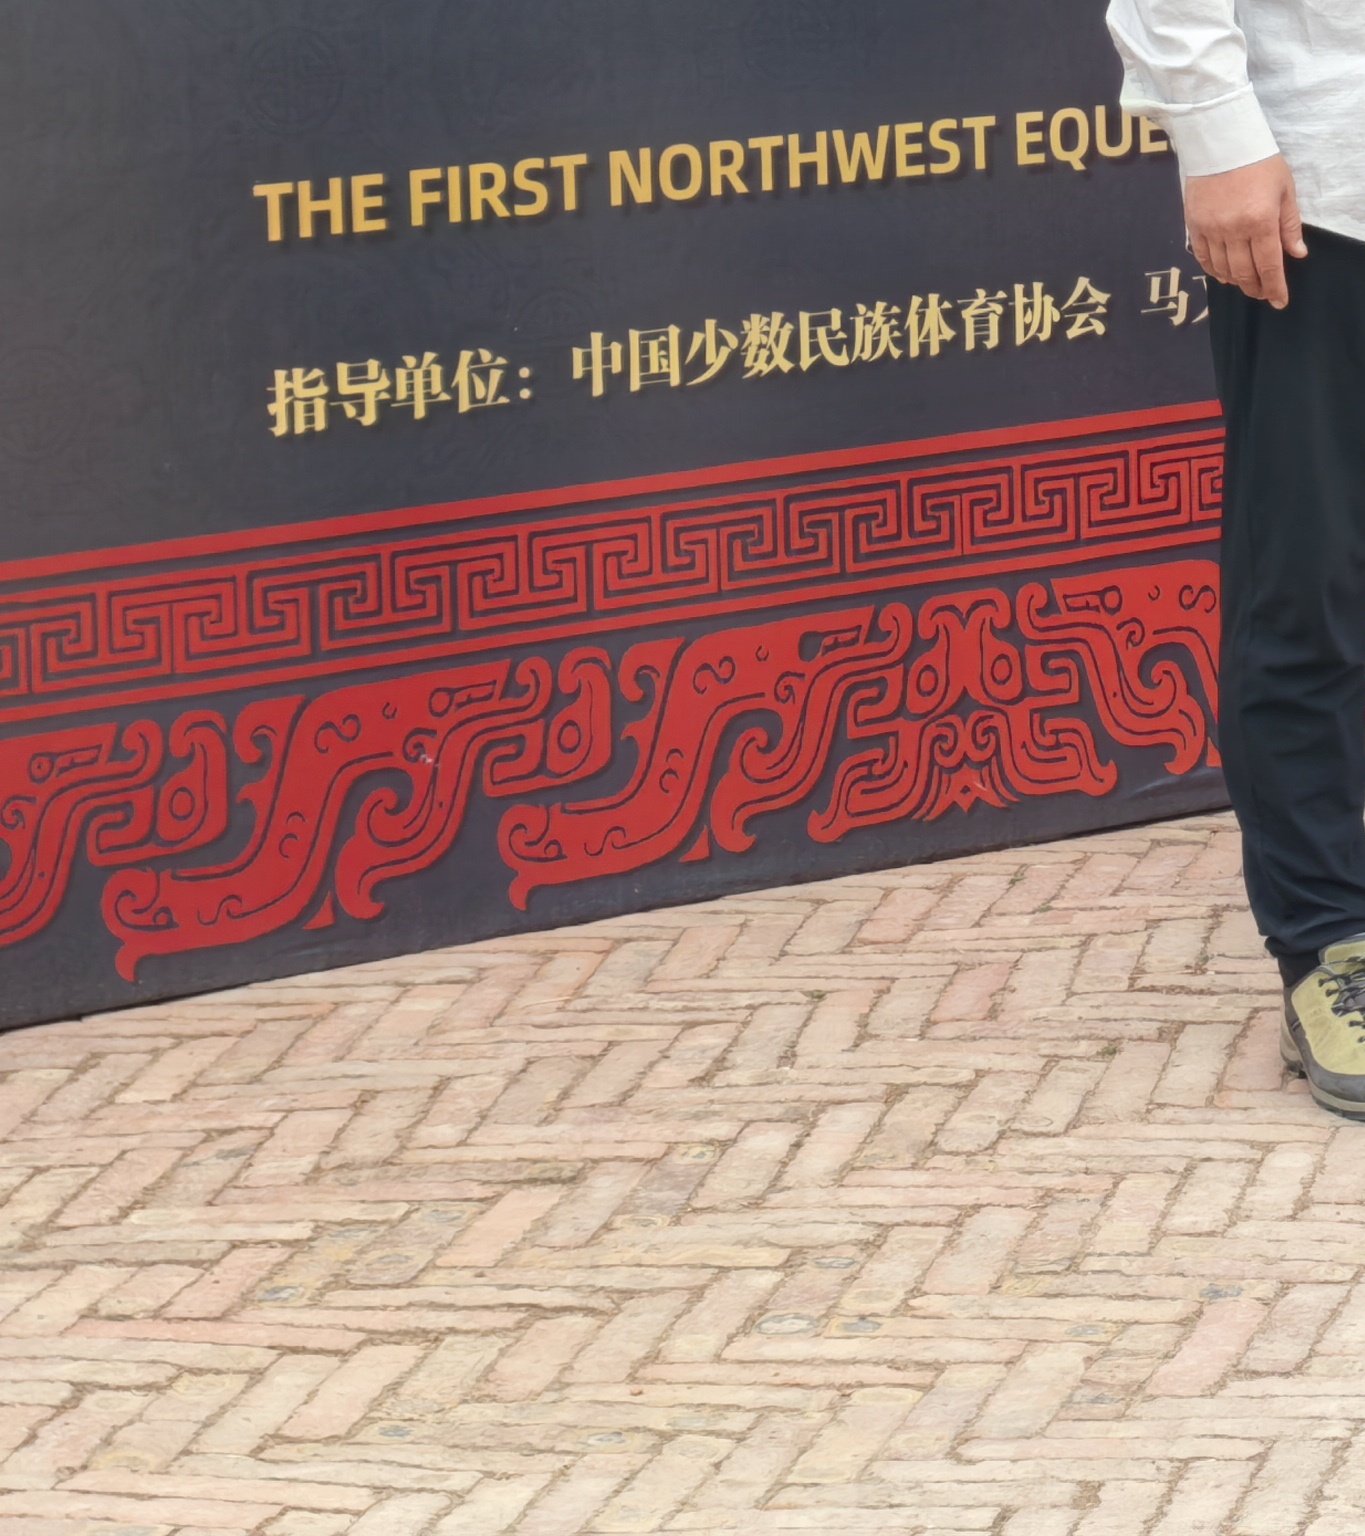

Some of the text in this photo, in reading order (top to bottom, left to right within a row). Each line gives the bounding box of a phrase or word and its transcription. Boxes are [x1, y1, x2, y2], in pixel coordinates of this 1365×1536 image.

[253, 172, 389, 242] THE
[409, 152, 588, 228] FIRST
[608, 115, 995, 208] NORTHWEST
